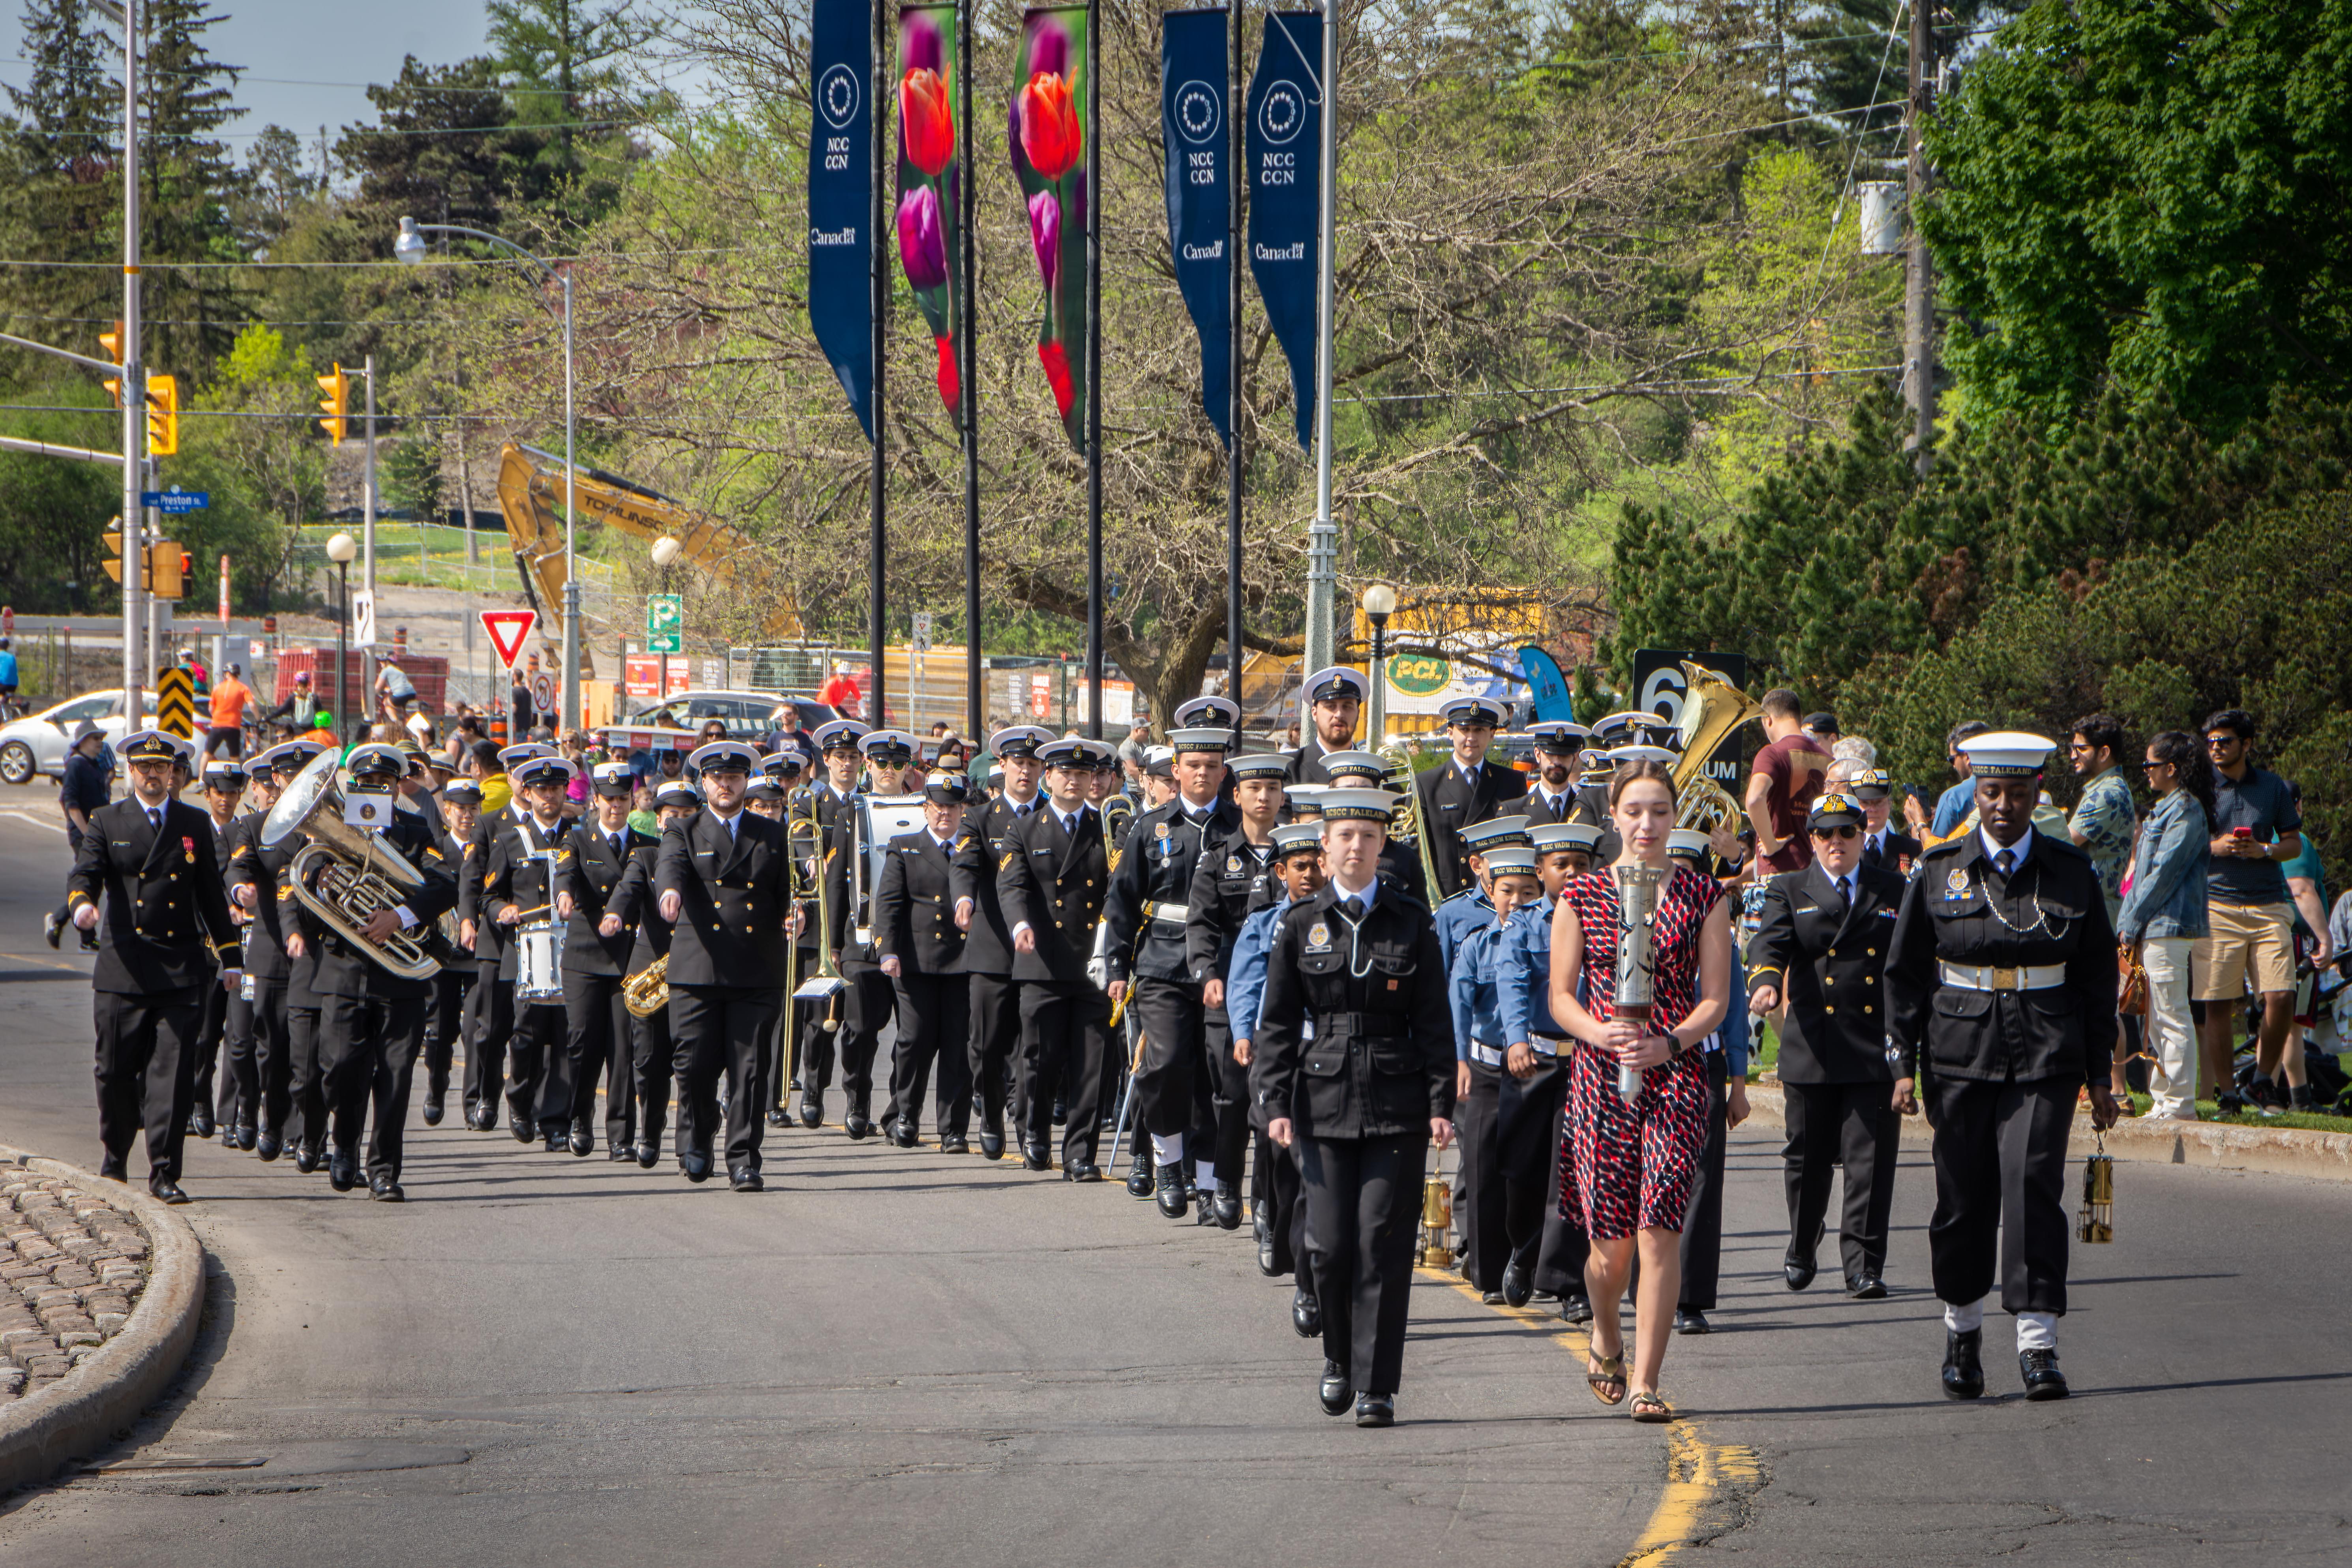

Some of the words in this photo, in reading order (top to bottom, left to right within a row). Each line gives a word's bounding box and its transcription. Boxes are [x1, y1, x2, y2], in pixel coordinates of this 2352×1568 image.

[827, 137, 850, 152] NCC
[825, 154, 849, 170] CCN
[1188, 152, 1214, 167] NCC
[1263, 153, 1294, 167] NCC
[1190, 169, 1214, 184] CCN
[1262, 171, 1295, 185] CCN
[811, 227, 855, 245] Canada
[1183, 240, 1223, 259] Canada
[1256, 238, 1304, 260] Canada
[160, 494, 191, 505] Preston
[654, 599, 676, 629] P
[1395, 660, 1442, 680] PCL
[1349, 766, 1379, 776] FALKLAND
[1990, 766, 2032, 775] FALKLAND
[1326, 808, 1347, 817] RCSCC
[1350, 808, 1386, 820] FALKLAND
[1488, 836, 1504, 844] VADM
